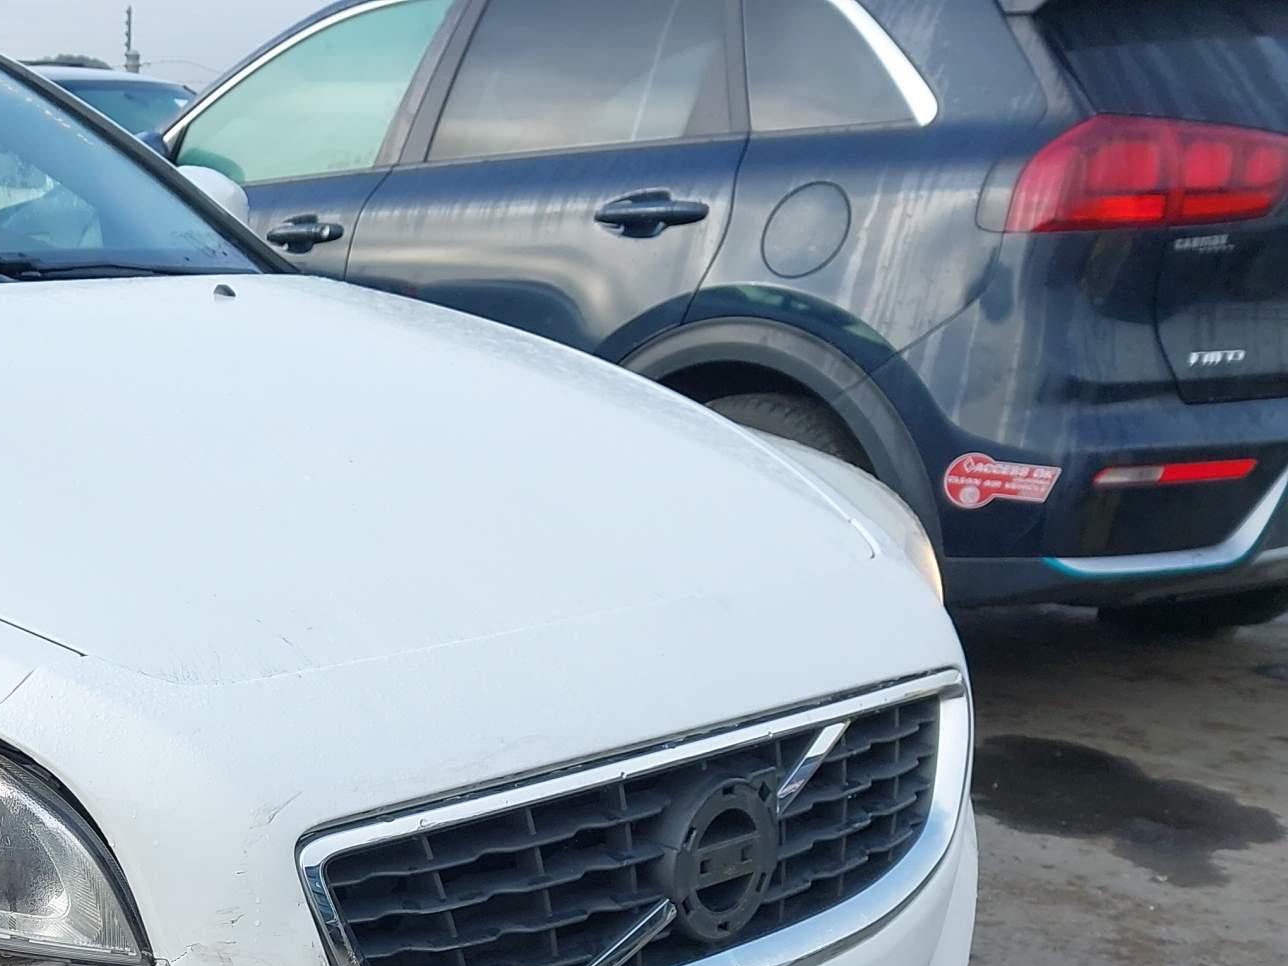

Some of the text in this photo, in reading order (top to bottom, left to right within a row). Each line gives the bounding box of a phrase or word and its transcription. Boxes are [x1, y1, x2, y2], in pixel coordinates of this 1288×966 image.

[974, 462, 1052, 478] ACCESS OK
[948, 475, 981, 486] CLEAN
[983, 479, 1002, 488] AIR
